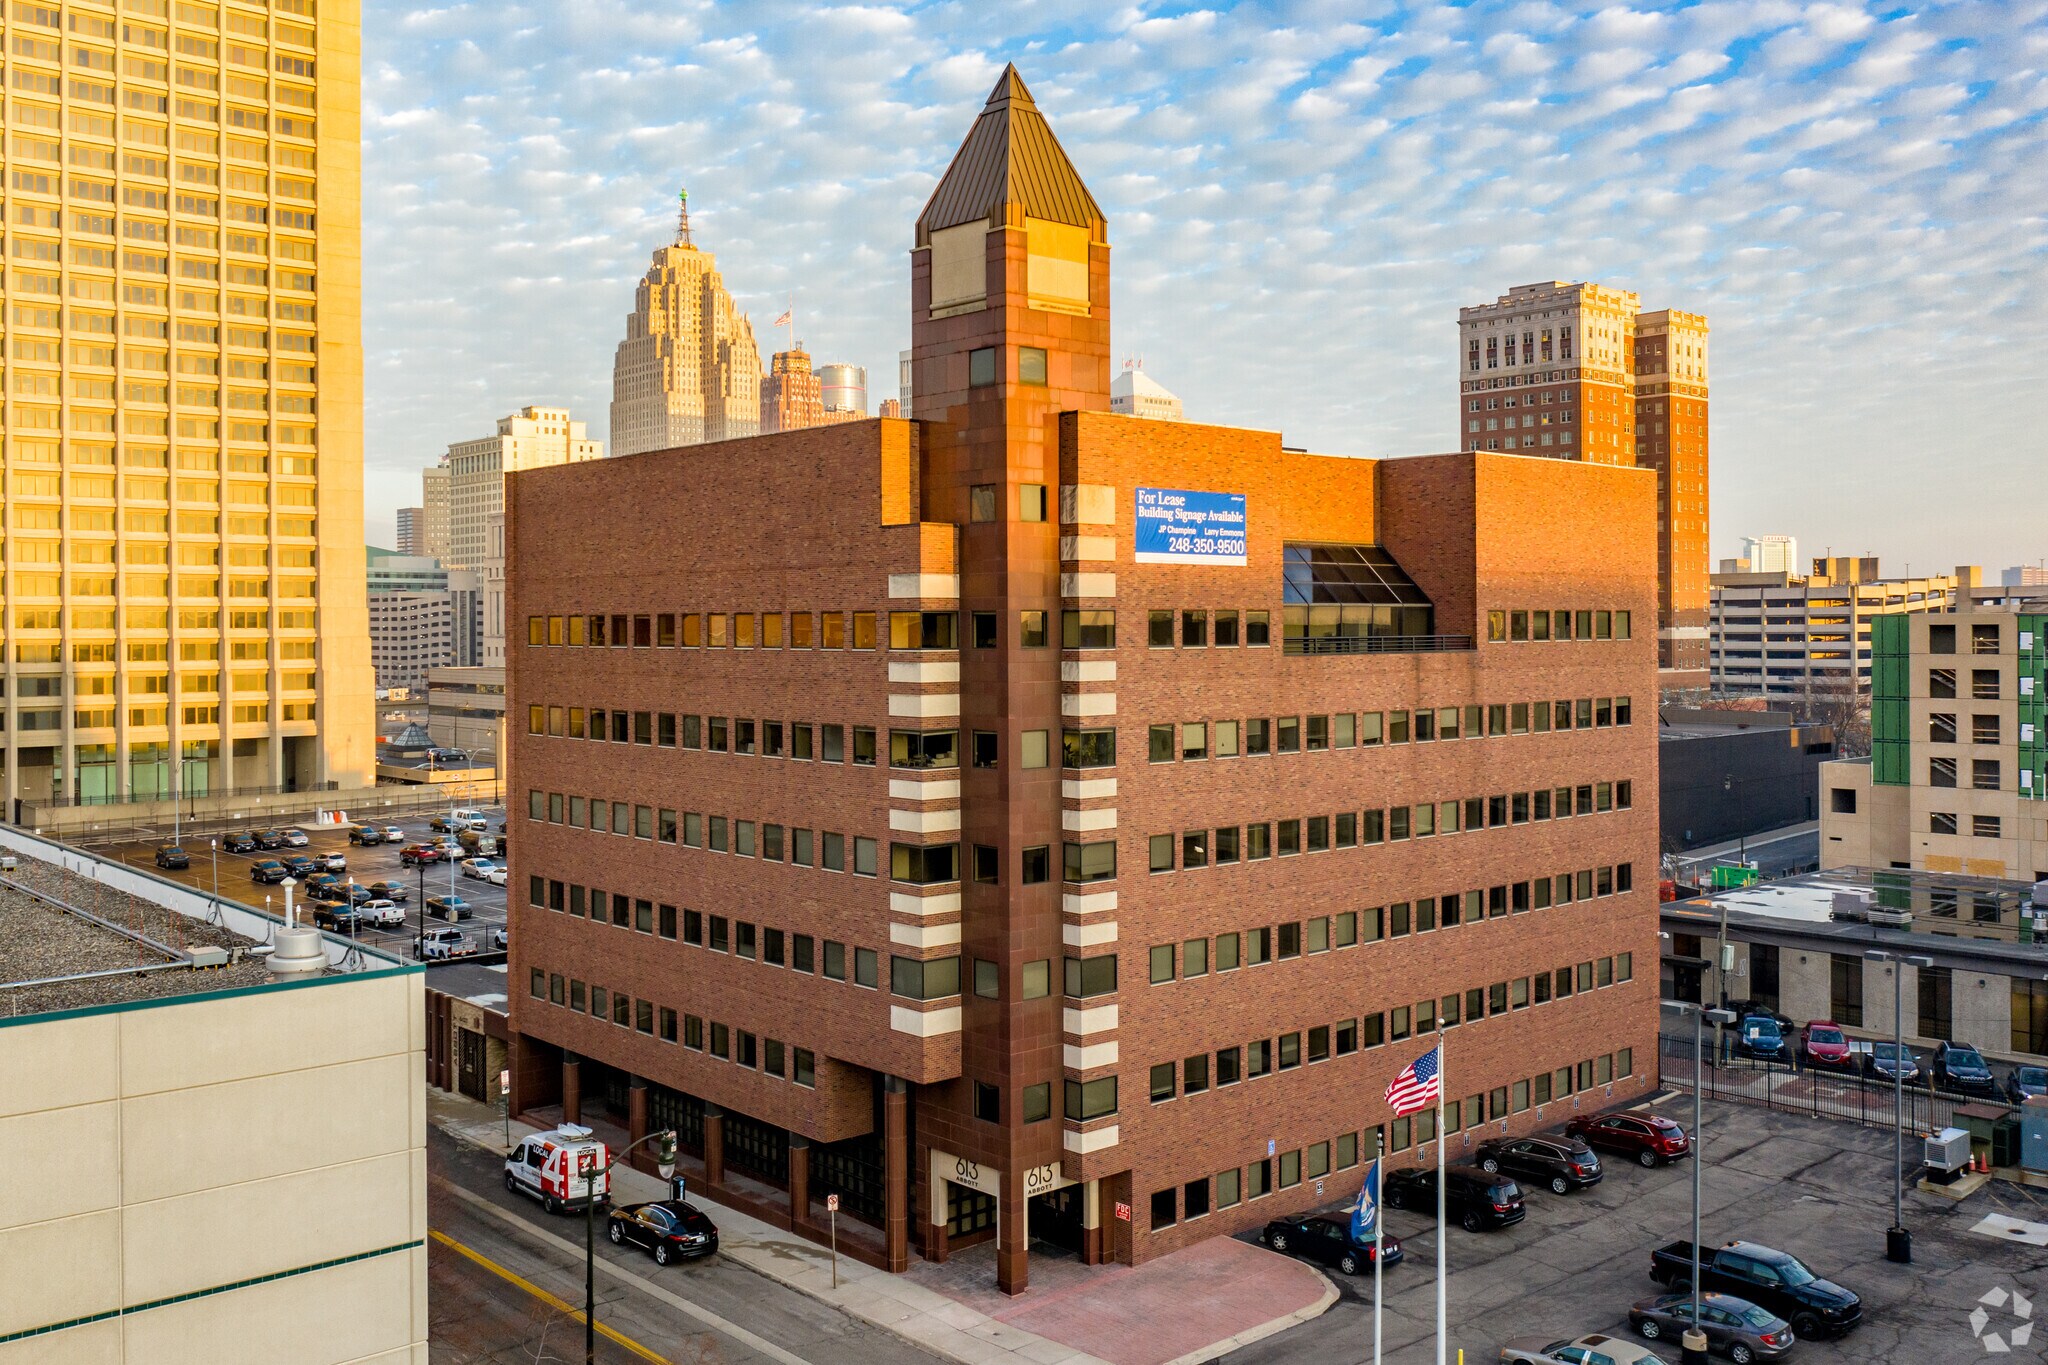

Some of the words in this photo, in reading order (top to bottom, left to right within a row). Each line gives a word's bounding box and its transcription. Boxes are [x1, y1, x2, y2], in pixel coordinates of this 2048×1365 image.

[1138, 490, 1156, 504] For
[1158, 491, 1186, 506] Lease
[1138, 505, 1174, 522] Building
[1175, 507, 1207, 524] Signage
[1208, 510, 1244, 523] Available
[1158, 525, 1167, 534] JP
[1167, 525, 1197, 535] Champine
[1204, 527, 1219, 537] Larry
[1219, 528, 1244, 537] Emmons
[1169, 537, 1244, 554] 248-350-9500
[533, 1145, 549, 1159] LOCAL
[542, 1147, 565, 1193] 4
[956, 1157, 979, 1180] 613
[1028, 1164, 1053, 1187] 613
[956, 1175, 979, 1188] ABBOTT
[1028, 1183, 1053, 1195] ABBOTT
